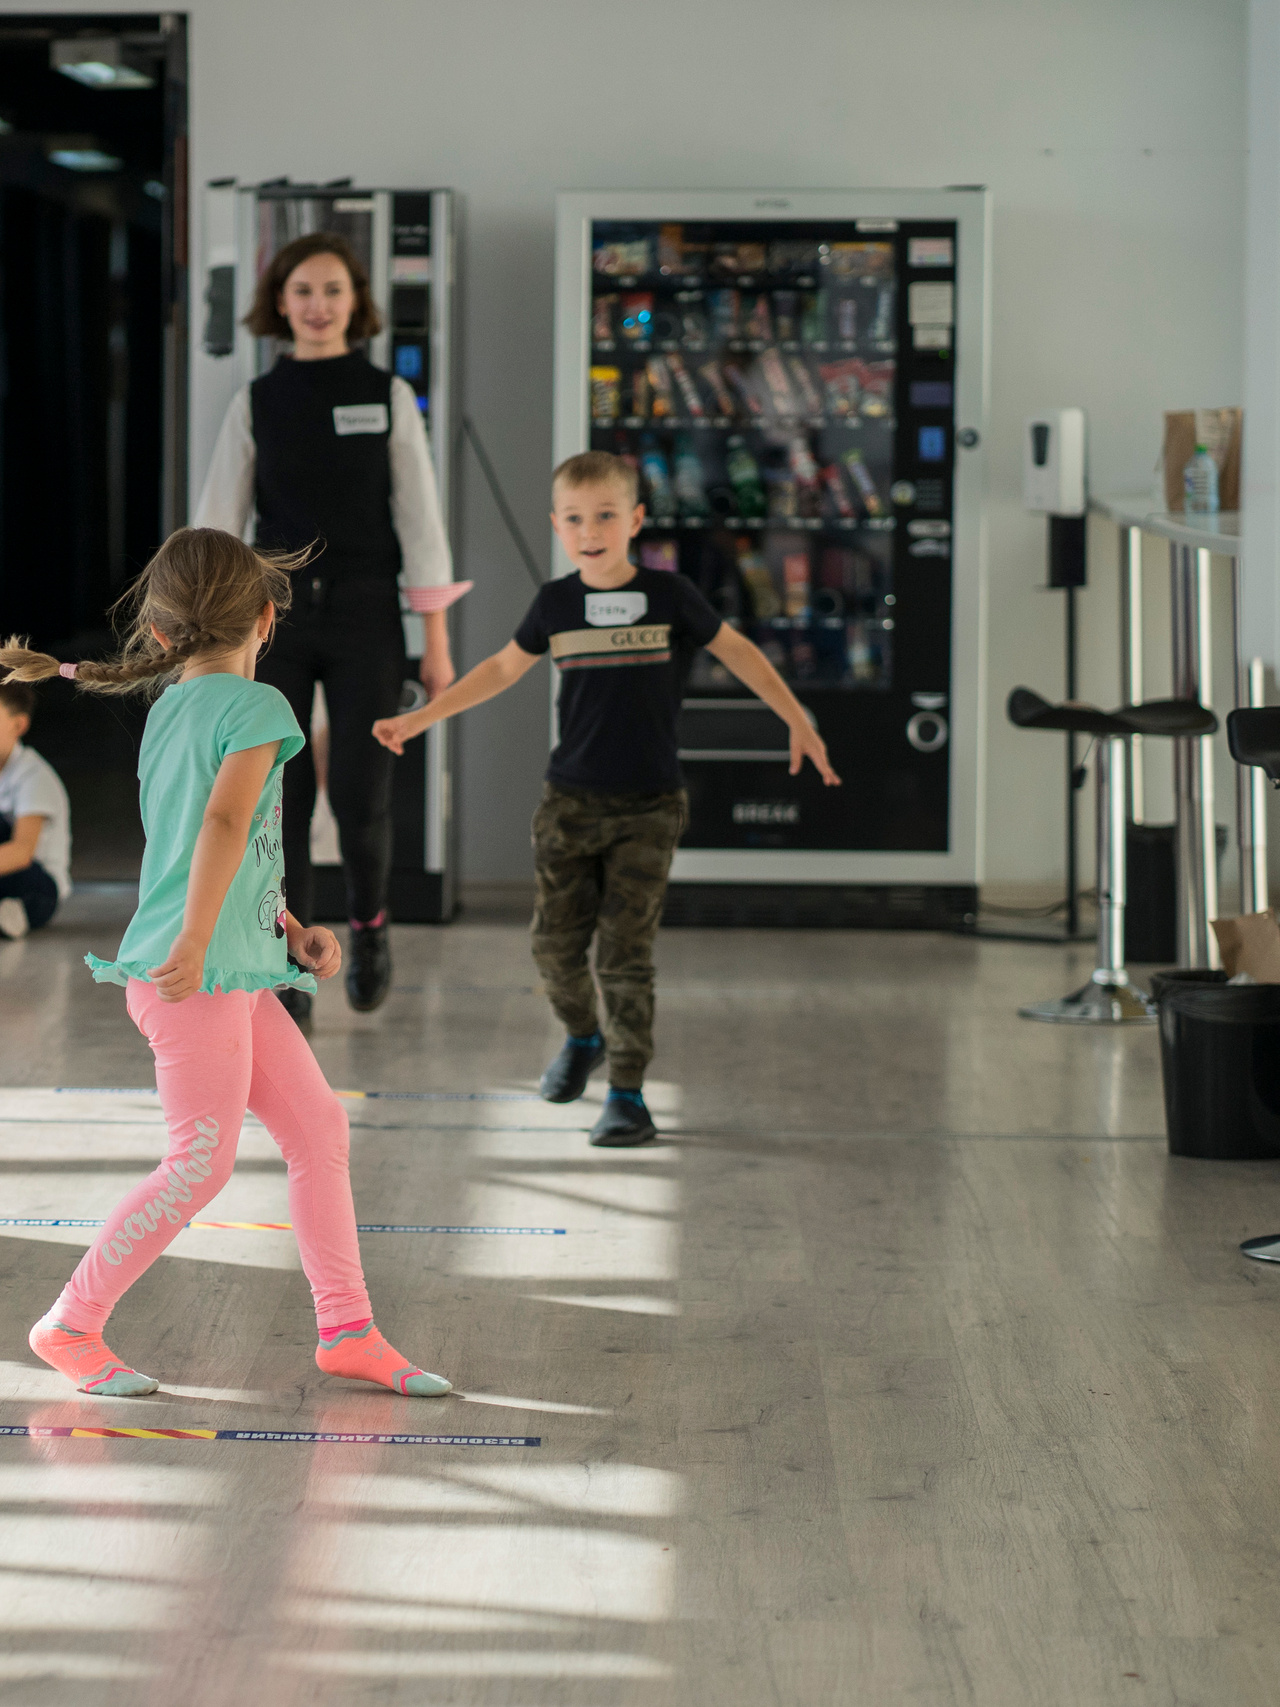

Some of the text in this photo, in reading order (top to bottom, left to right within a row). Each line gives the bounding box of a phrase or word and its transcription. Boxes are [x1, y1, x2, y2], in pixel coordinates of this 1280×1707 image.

[252, 833, 282, 868] Min
[101, 1115, 220, 1265] everywhere
[66, 1341, 108, 1361] DRE
[236, 1432, 526, 1445] БЕЗОПАСНАЯ ДИСТАНЦИЯ
